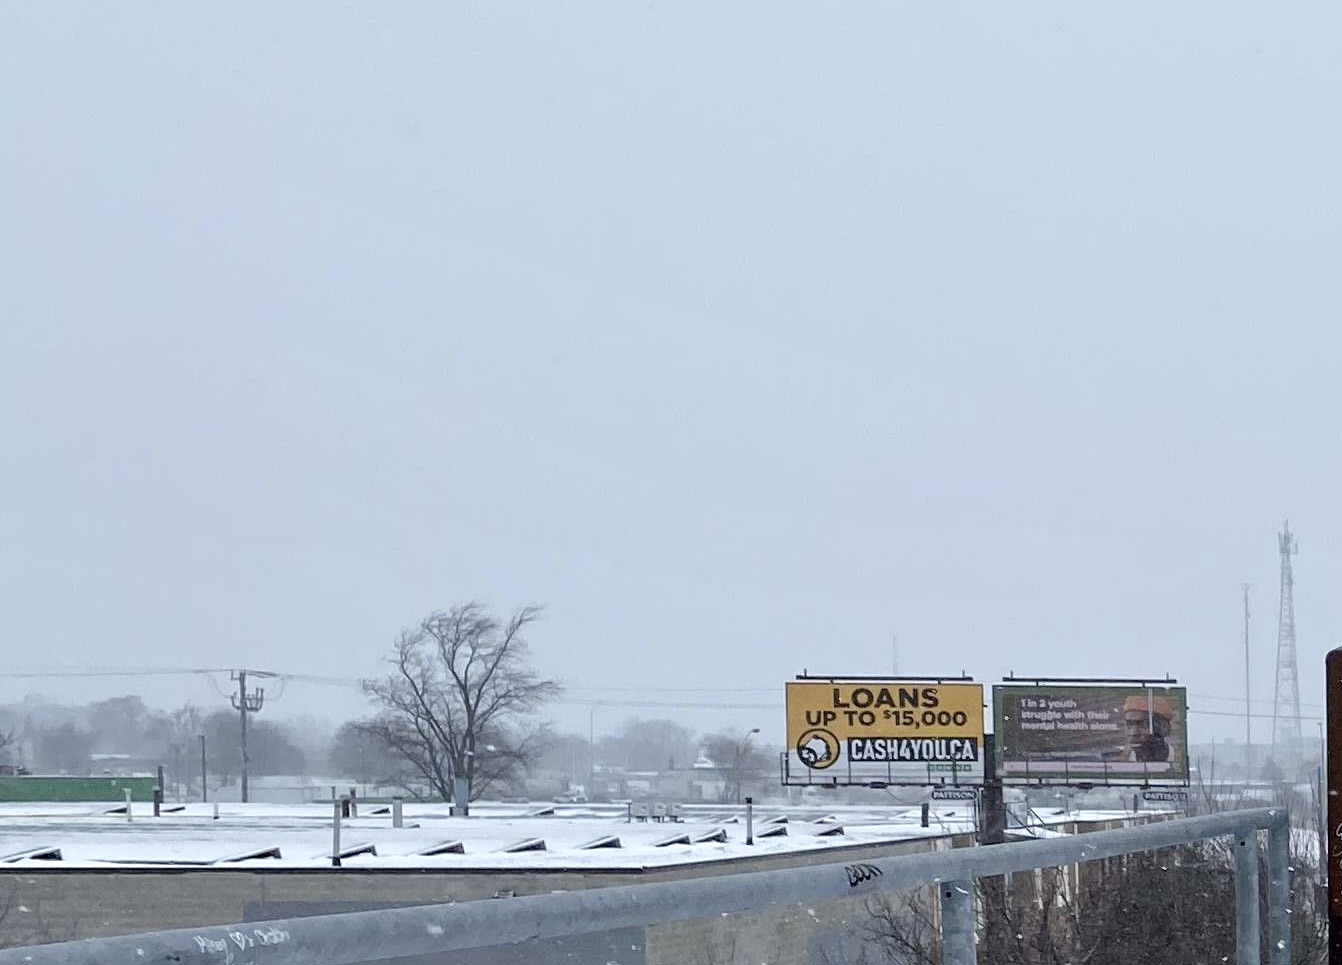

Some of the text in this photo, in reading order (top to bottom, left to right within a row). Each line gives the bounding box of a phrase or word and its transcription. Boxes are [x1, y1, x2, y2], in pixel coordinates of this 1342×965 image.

[833, 688, 939, 708] LOANS
[1027, 699, 1037, 708] in
[1039, 699, 1047, 708] 2
[1048, 699, 1078, 710] youth
[805, 709, 968, 729] UP TO $15,000
[1021, 711, 1110, 721] struggle with their
[1021, 721, 1055, 730] mental
[1056, 721, 1089, 730] health
[850, 739, 975, 761] CASH4YOU.CA
[933, 791, 975, 799] PATTISON
